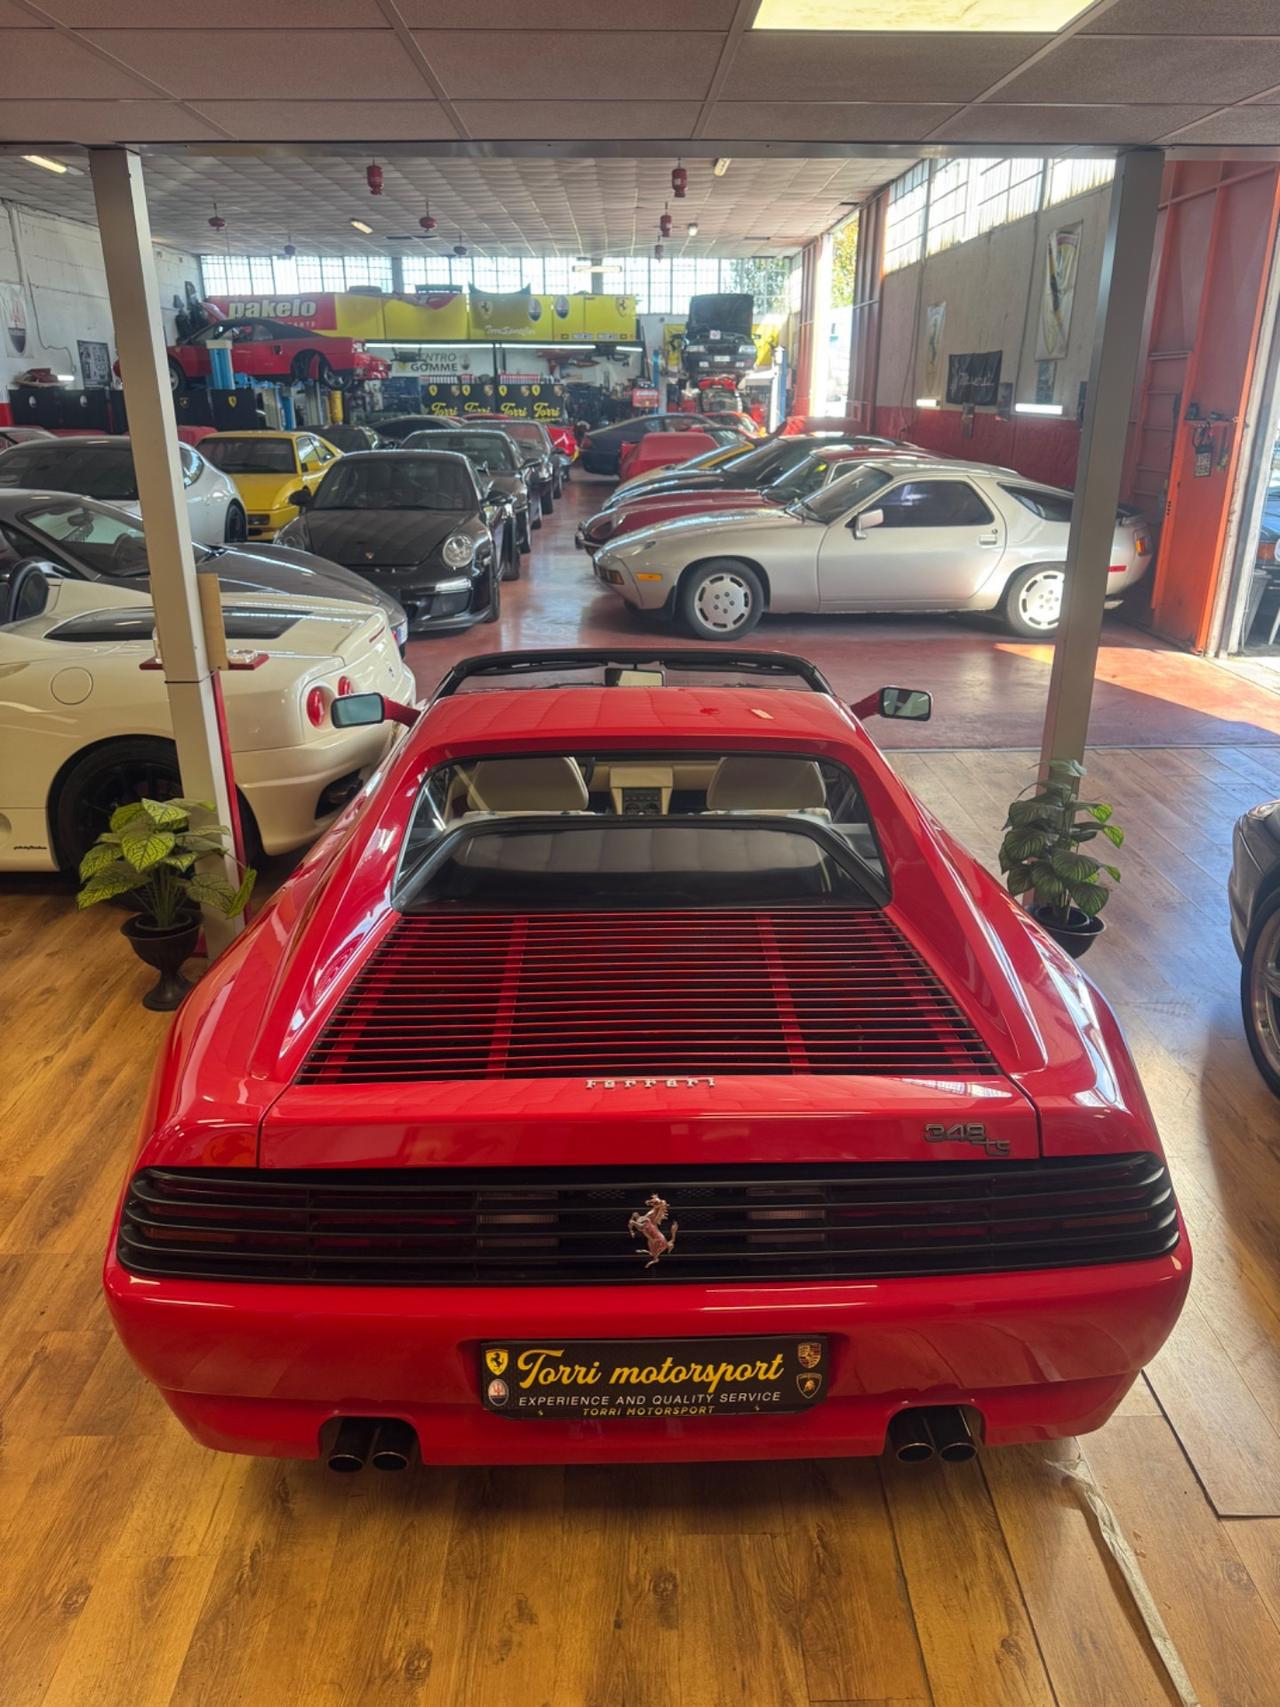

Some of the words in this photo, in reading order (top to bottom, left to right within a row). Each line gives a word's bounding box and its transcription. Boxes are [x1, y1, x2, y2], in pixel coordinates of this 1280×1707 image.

[228, 299, 317, 319] pakelo
[417, 352, 457, 362] ENTRO
[410, 363, 458, 371] GOMME
[431, 402, 458, 416] Torri
[500, 402, 528, 417] Torri
[533, 402, 560, 418] Torri
[585, 1077, 715, 1089] Ferrari
[924, 1122, 985, 1143] 348
[517, 1349, 601, 1389] Torri
[608, 1352, 785, 1393] motorsport
[518, 1395, 610, 1406] EXPERIENCE
[615, 1395, 647, 1405] AND
[652, 1393, 714, 1405] QUALITY
[719, 1391, 781, 1403] SERVICE
[583, 1407, 622, 1416] TORRI
[626, 1405, 715, 1416] MOTORSPORT
